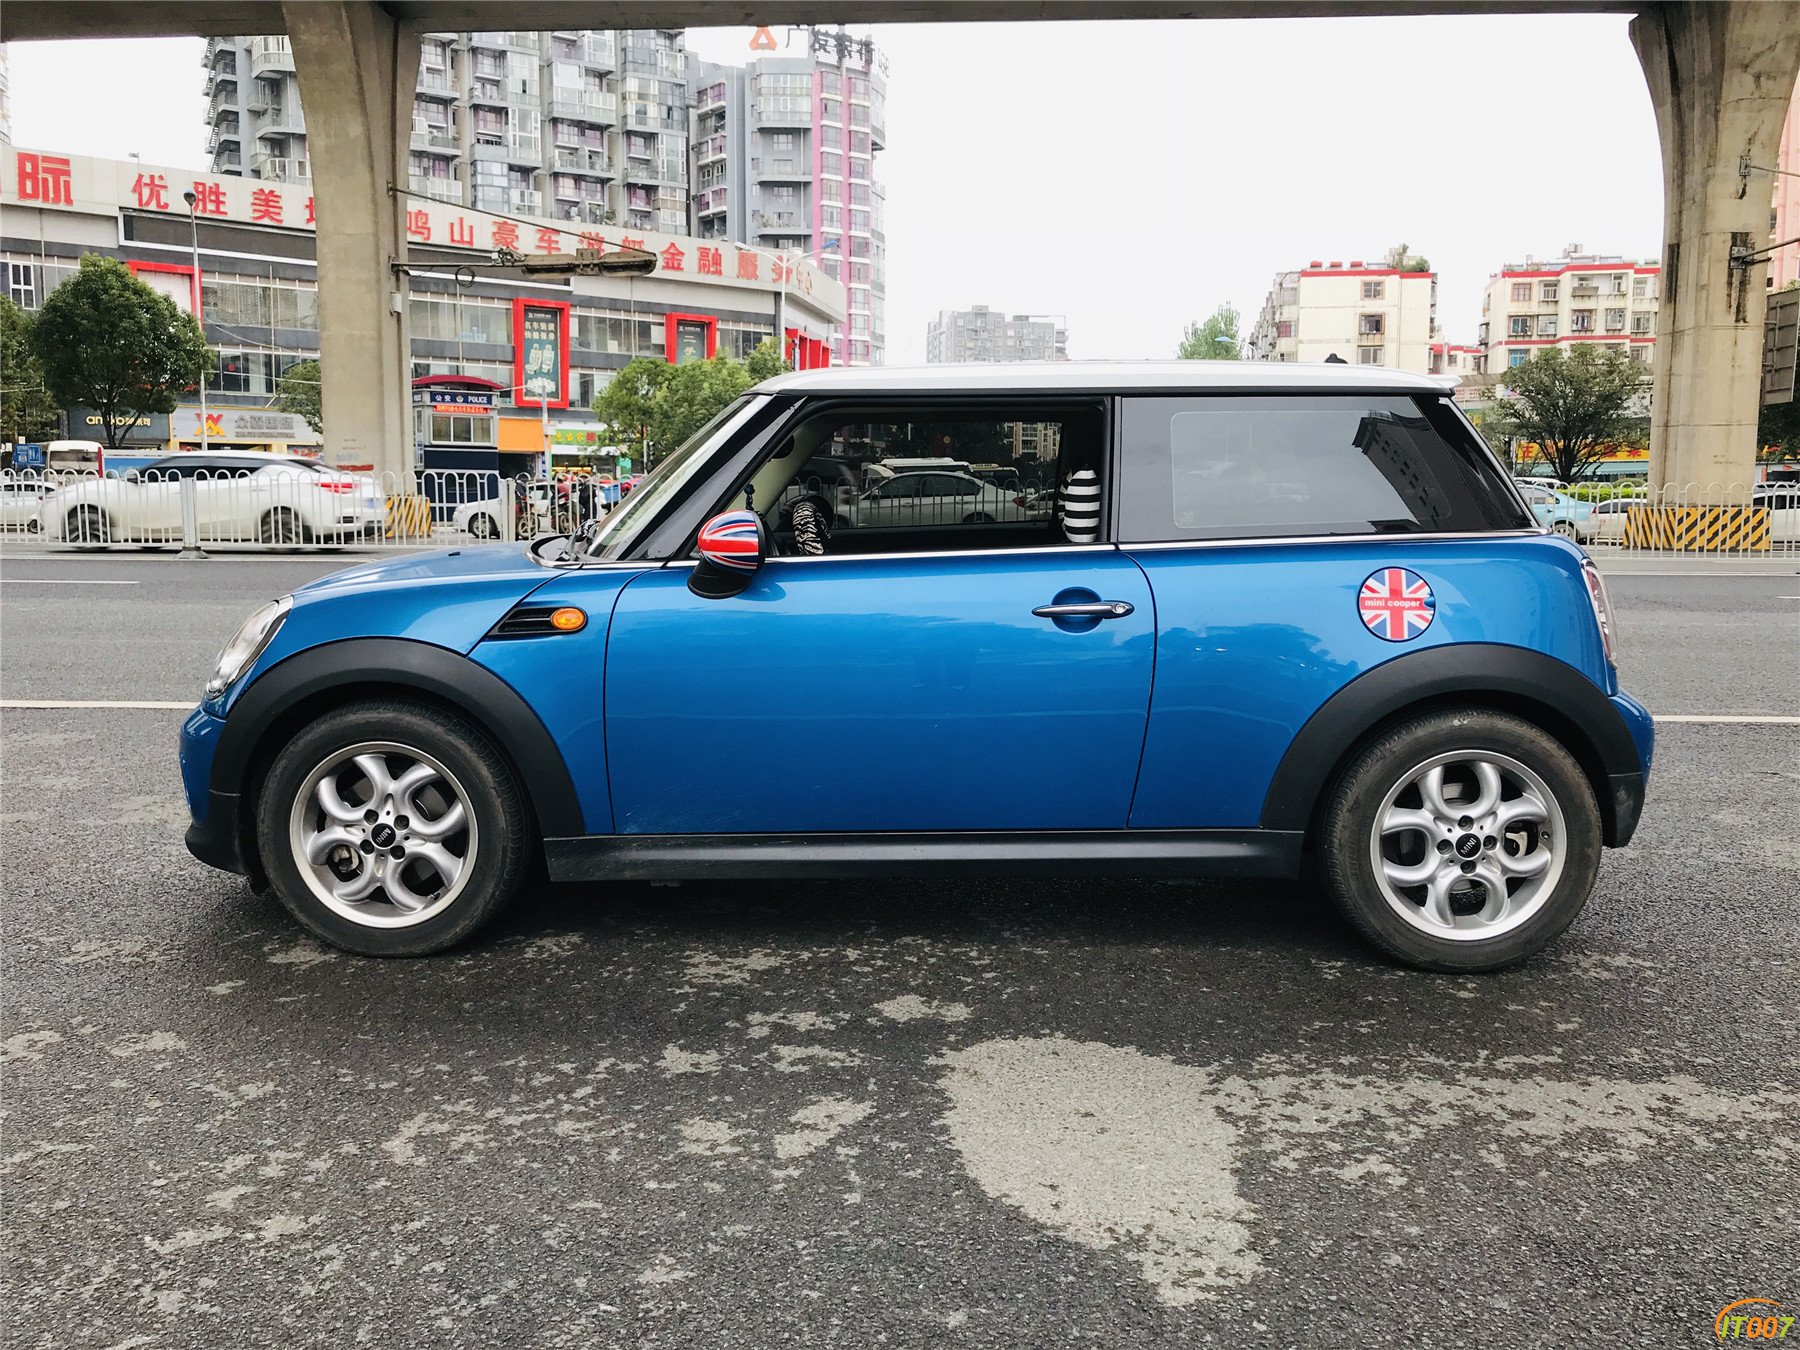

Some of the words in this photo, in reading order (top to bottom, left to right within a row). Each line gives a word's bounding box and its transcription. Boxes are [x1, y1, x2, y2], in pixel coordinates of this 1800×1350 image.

[132, 173, 315, 225] 优胜美
[435, 394, 451, 402] 公安
[468, 395, 488, 403] POLICE
[1364, 599, 1385, 607] mini
[1387, 599, 1421, 608] cooper
[1460, 837, 1477, 855] MINI
